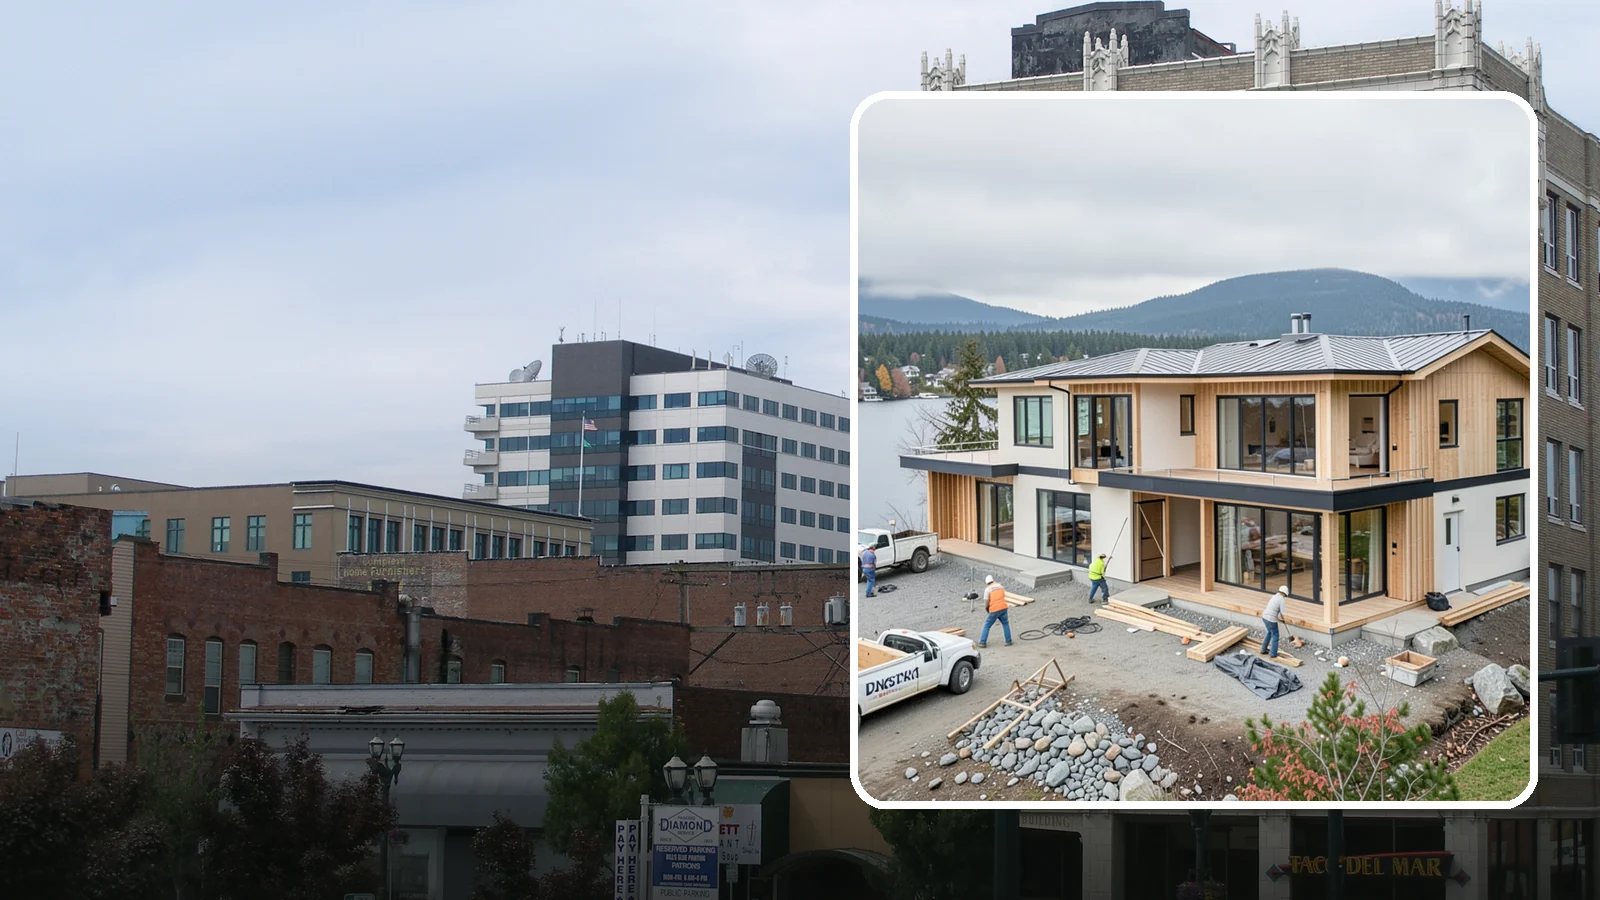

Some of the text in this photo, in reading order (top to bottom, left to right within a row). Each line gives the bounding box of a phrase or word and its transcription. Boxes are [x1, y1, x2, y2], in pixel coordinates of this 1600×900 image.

[660, 818, 713, 832] DIAMOND
[1022, 815, 1070, 828] BUILDING
[655, 845, 716, 854] RESERVED PARKING
[616, 825, 625, 893] PAY HERE
[627, 825, 636, 893] PAY HERE
[721, 852, 739, 862] Soup
[671, 862, 701, 870] PATRONS
[1289, 856, 1442, 877] TAC DEL MAR
[660, 888, 710, 898] PUBLIC PARKING
